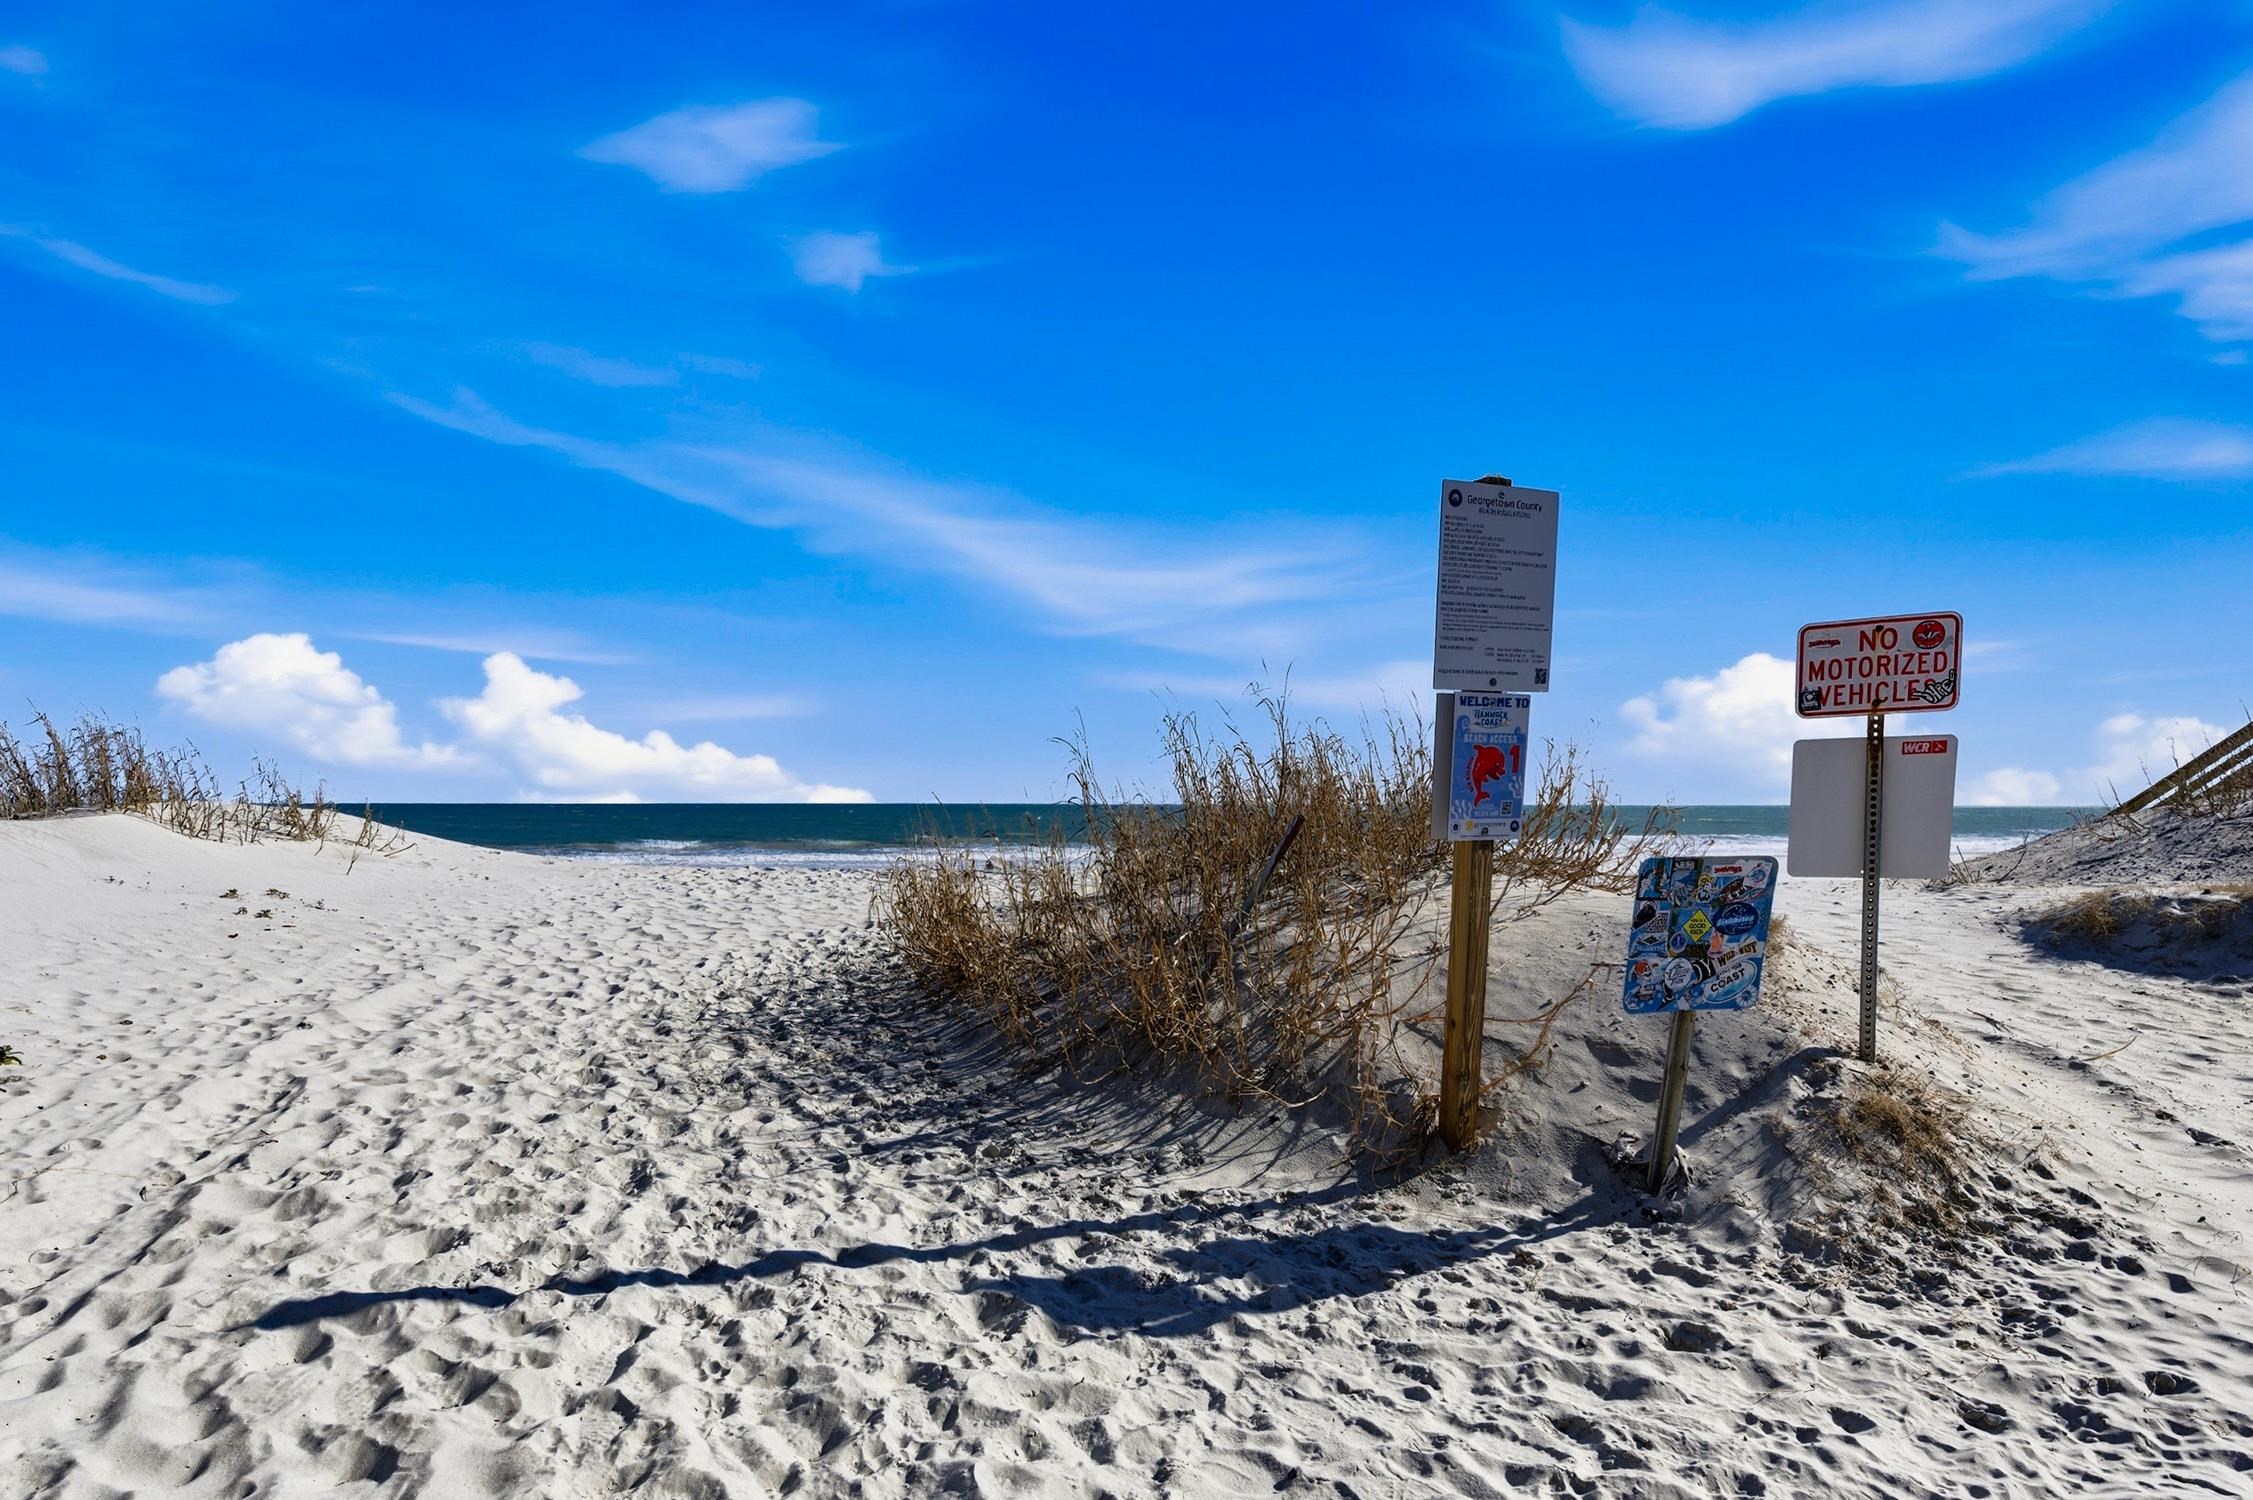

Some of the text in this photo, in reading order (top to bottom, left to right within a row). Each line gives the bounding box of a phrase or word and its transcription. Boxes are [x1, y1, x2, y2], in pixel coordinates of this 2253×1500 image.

[1467, 494, 1543, 512] Georgetown County
[1859, 627, 1898, 652] NO
[1808, 651, 1948, 682] MOTORIZED
[1515, 698, 1530, 708] TO
[1480, 717, 1503, 726] COAST
[1489, 734, 1518, 743] ACCESS
[1903, 742, 1930, 753] WCR
[1509, 744, 1521, 774] 1
[1711, 968, 1745, 993] COAST
